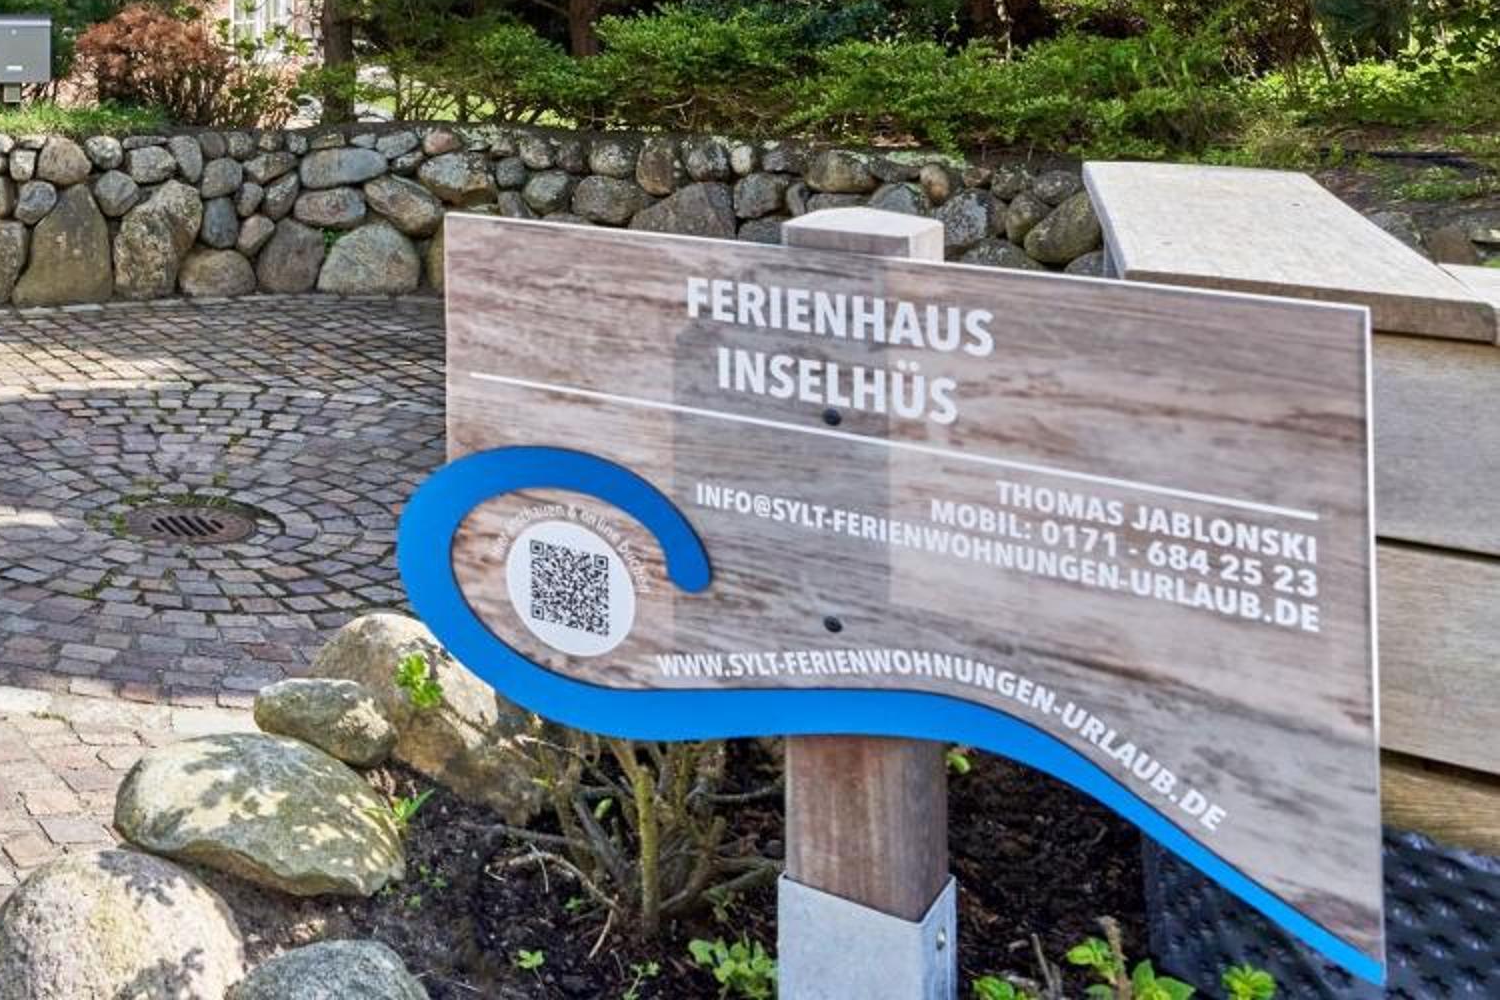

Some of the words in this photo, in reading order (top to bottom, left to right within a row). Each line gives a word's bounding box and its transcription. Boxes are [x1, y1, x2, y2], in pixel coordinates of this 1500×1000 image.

[686, 277, 995, 357] FERIENHAUS
[717, 347, 959, 425] INSELHÜS
[696, 483, 1321, 633] INFO@SYLT-FERIENWOHNUNGEN-URLAUB.DE
[931, 499, 1031, 540] MOBIL:
[1041, 519, 1118, 558] 0171
[1147, 543, 1211, 576] 684
[1220, 555, 1263, 587] 25
[1273, 565, 1318, 598] 23
[997, 480, 1124, 526] THOMAS
[1131, 506, 1318, 563] JABLONSKI
[656, 649, 1227, 831] WWW.SYLT-FERIENWOHNUNGEN-URLAUB.DE
